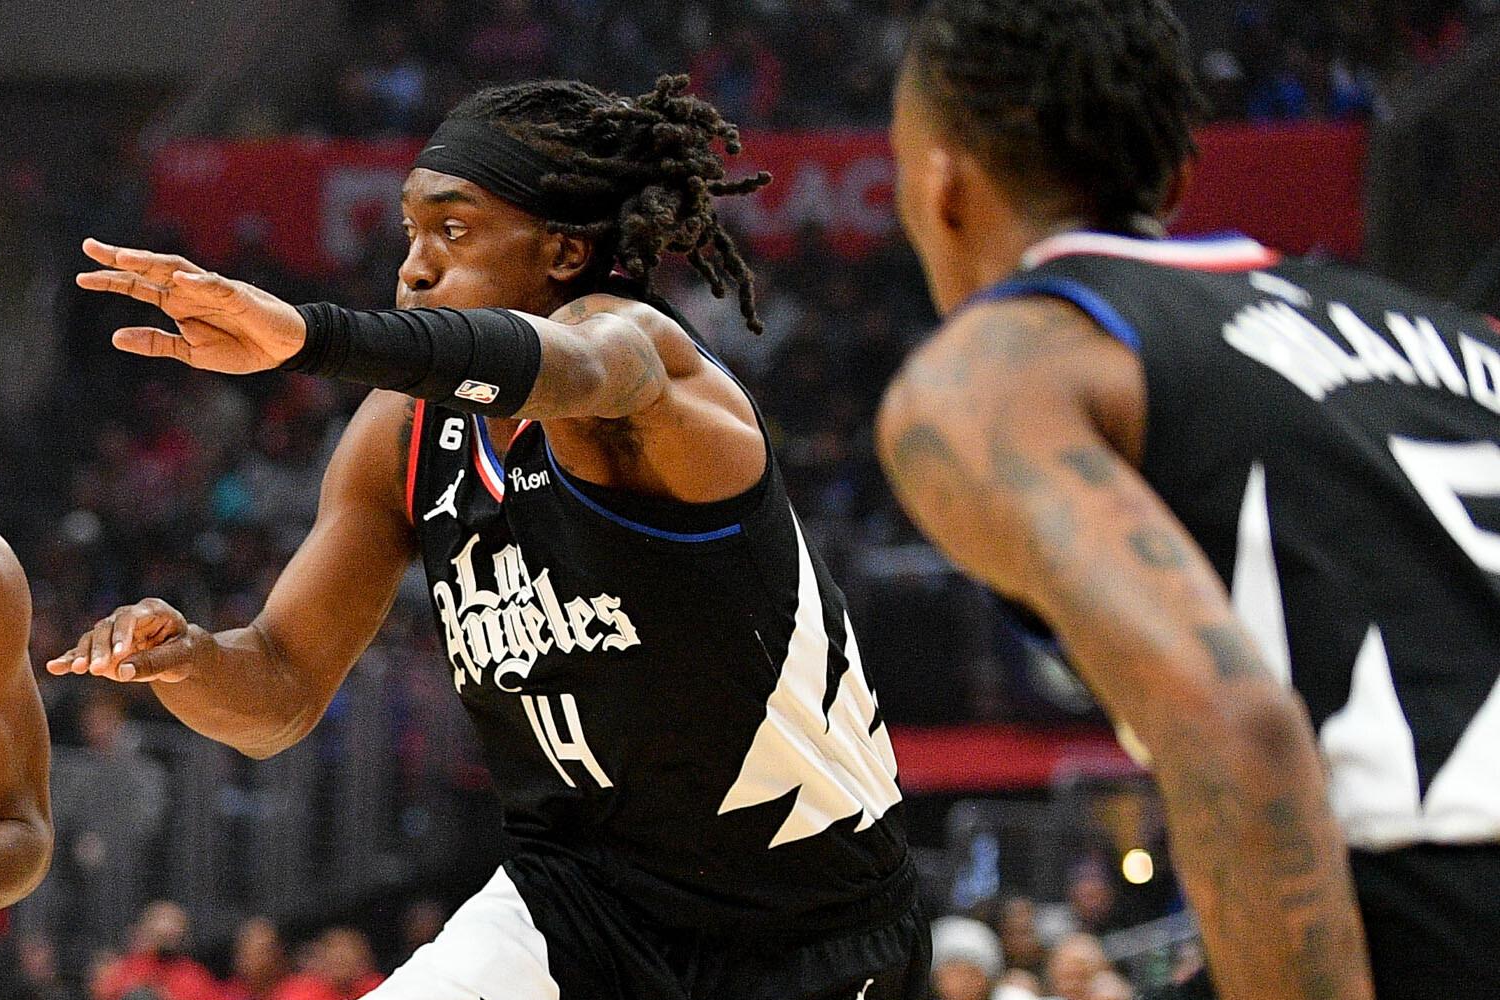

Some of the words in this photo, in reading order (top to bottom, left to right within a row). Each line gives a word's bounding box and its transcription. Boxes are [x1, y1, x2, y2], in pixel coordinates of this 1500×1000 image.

[439, 417, 465, 450] 6
[433, 568, 642, 694] Angeles
[520, 693, 614, 788] 14
